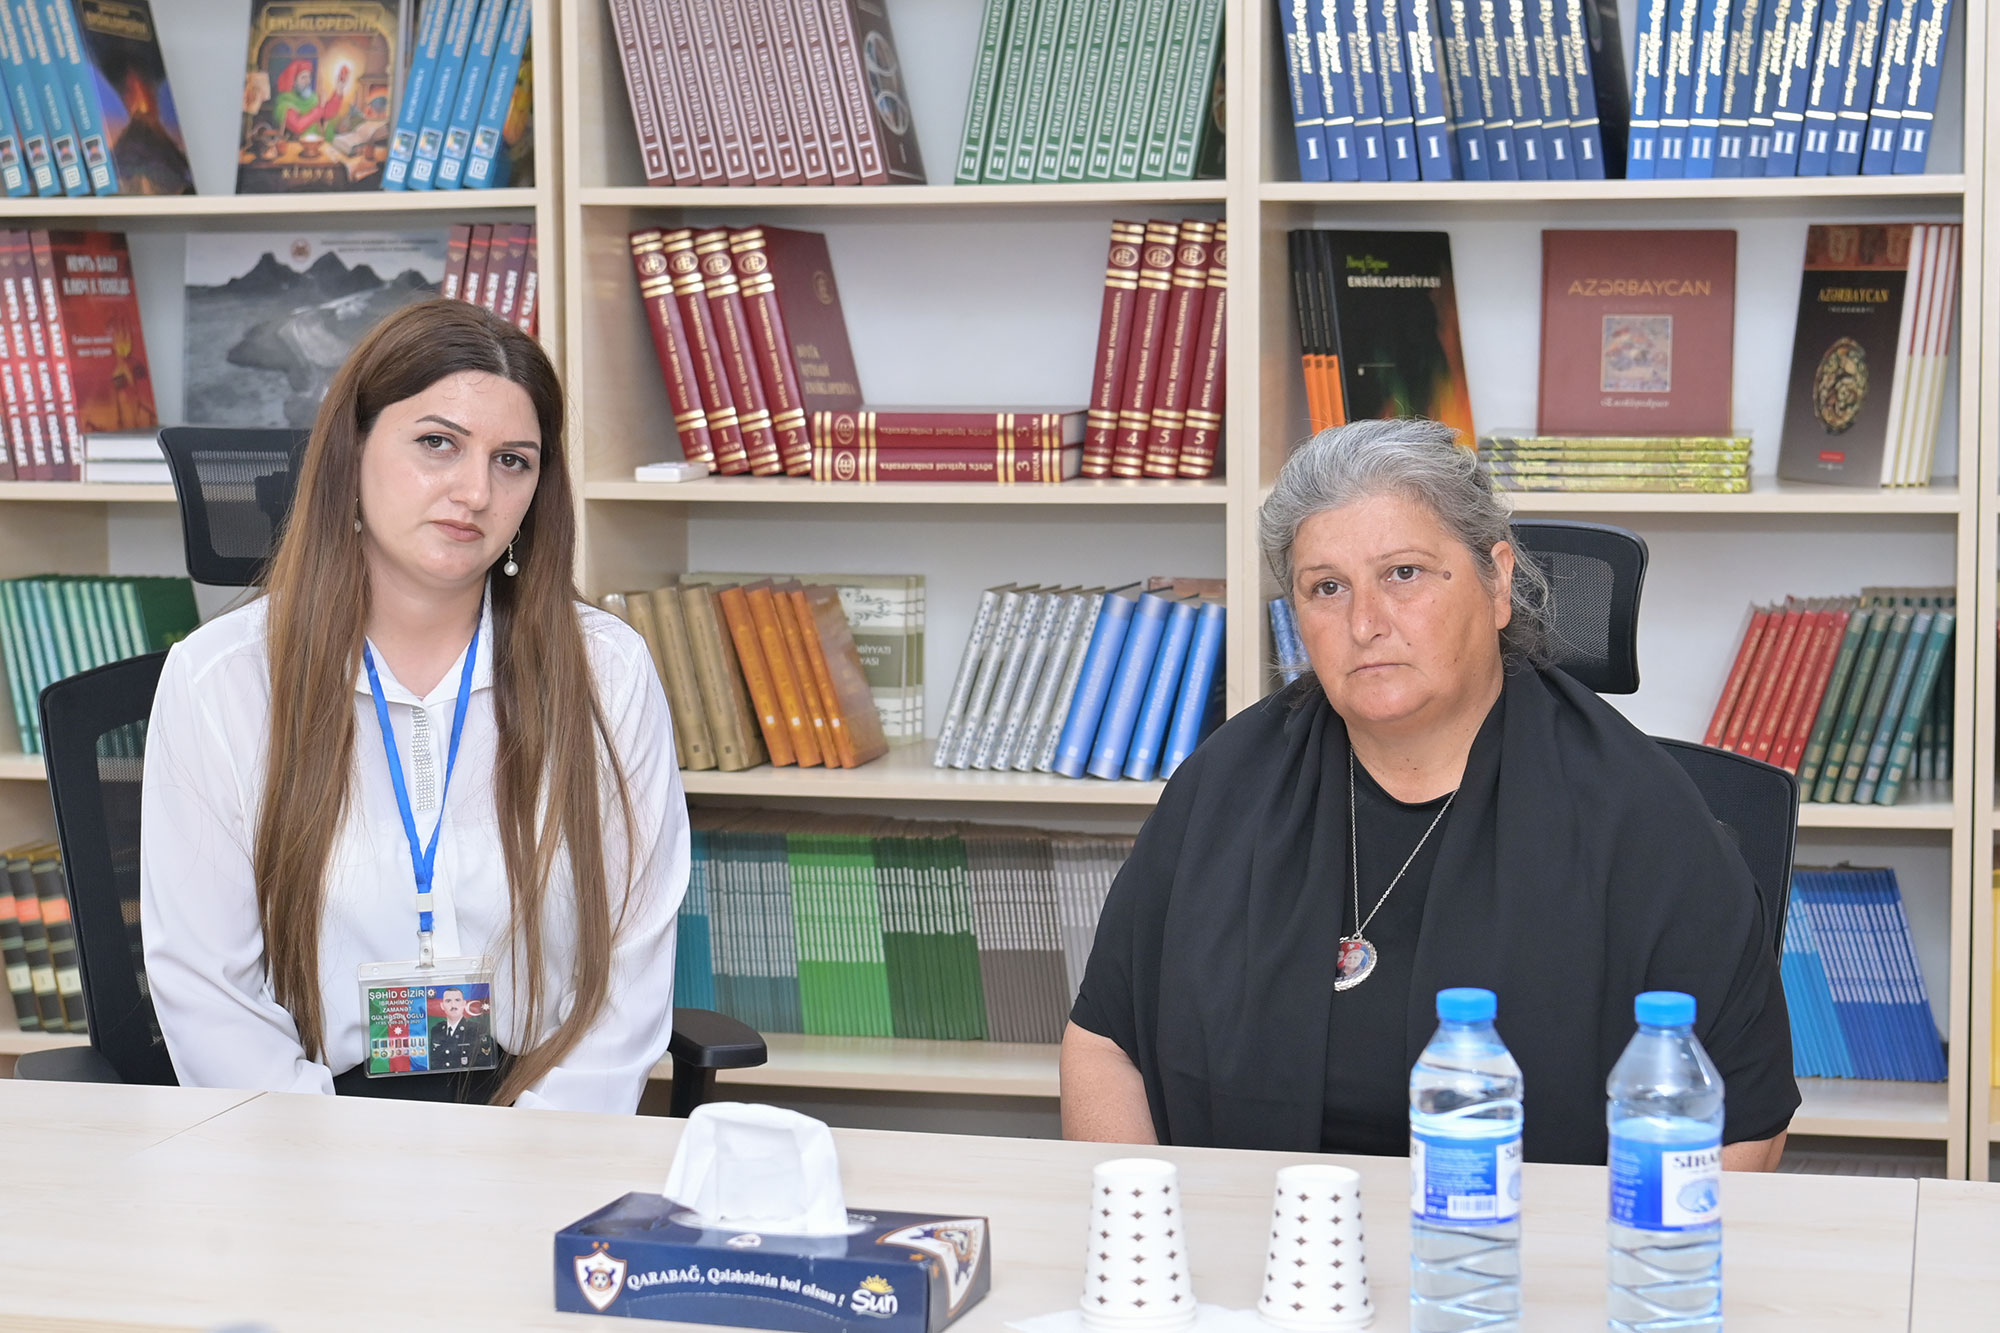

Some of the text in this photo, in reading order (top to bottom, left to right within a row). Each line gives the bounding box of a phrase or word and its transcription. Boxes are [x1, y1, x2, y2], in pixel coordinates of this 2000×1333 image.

[1307, 137, 1319, 159] I
[1336, 137, 1348, 159] I
[1366, 136, 1378, 159] I
[1395, 136, 1407, 159] I
[1428, 135, 1440, 158] I
[1468, 139, 1479, 161] I
[1496, 139, 1508, 161] I
[1525, 139, 1537, 160] I
[1554, 138, 1566, 160] I
[1582, 137, 1594, 159] I
[1633, 138, 1653, 160] II
[1662, 137, 1682, 159] II
[1691, 137, 1711, 159] II
[1720, 136, 1741, 159] II
[1749, 136, 1770, 157] II
[1773, 130, 1796, 154] II
[1805, 129, 1828, 153] II
[1836, 129, 1859, 153] II
[1871, 128, 1893, 151] II
[1902, 129, 1924, 152] II
[1347, 274, 1441, 288] ENSİKLOPEDİYASI
[1568, 279, 1712, 296] AZƏRBAYCAN
[1818, 288, 1889, 303] AZƏRBAYCAN
[720, 430, 729, 442] 1
[753, 432, 764, 445] 2
[788, 431, 799, 444] 2
[1016, 426, 1029, 437] 3
[1095, 430, 1106, 444] 4
[1127, 431, 1138, 445] 4
[1159, 429, 1170, 443] 5
[1194, 430, 1206, 444] 5
[1016, 461, 1030, 472] 3
[369, 988, 424, 1000] ŞƏHİD GİZİR
[626, 1264, 705, 1291] QARABAĞ,
[706, 1268, 779, 1289] Qələbələrin
[779, 1275, 801, 1294] bol
[801, 1283, 837, 1305] olsun
[850, 1289, 898, 1315] Sun
